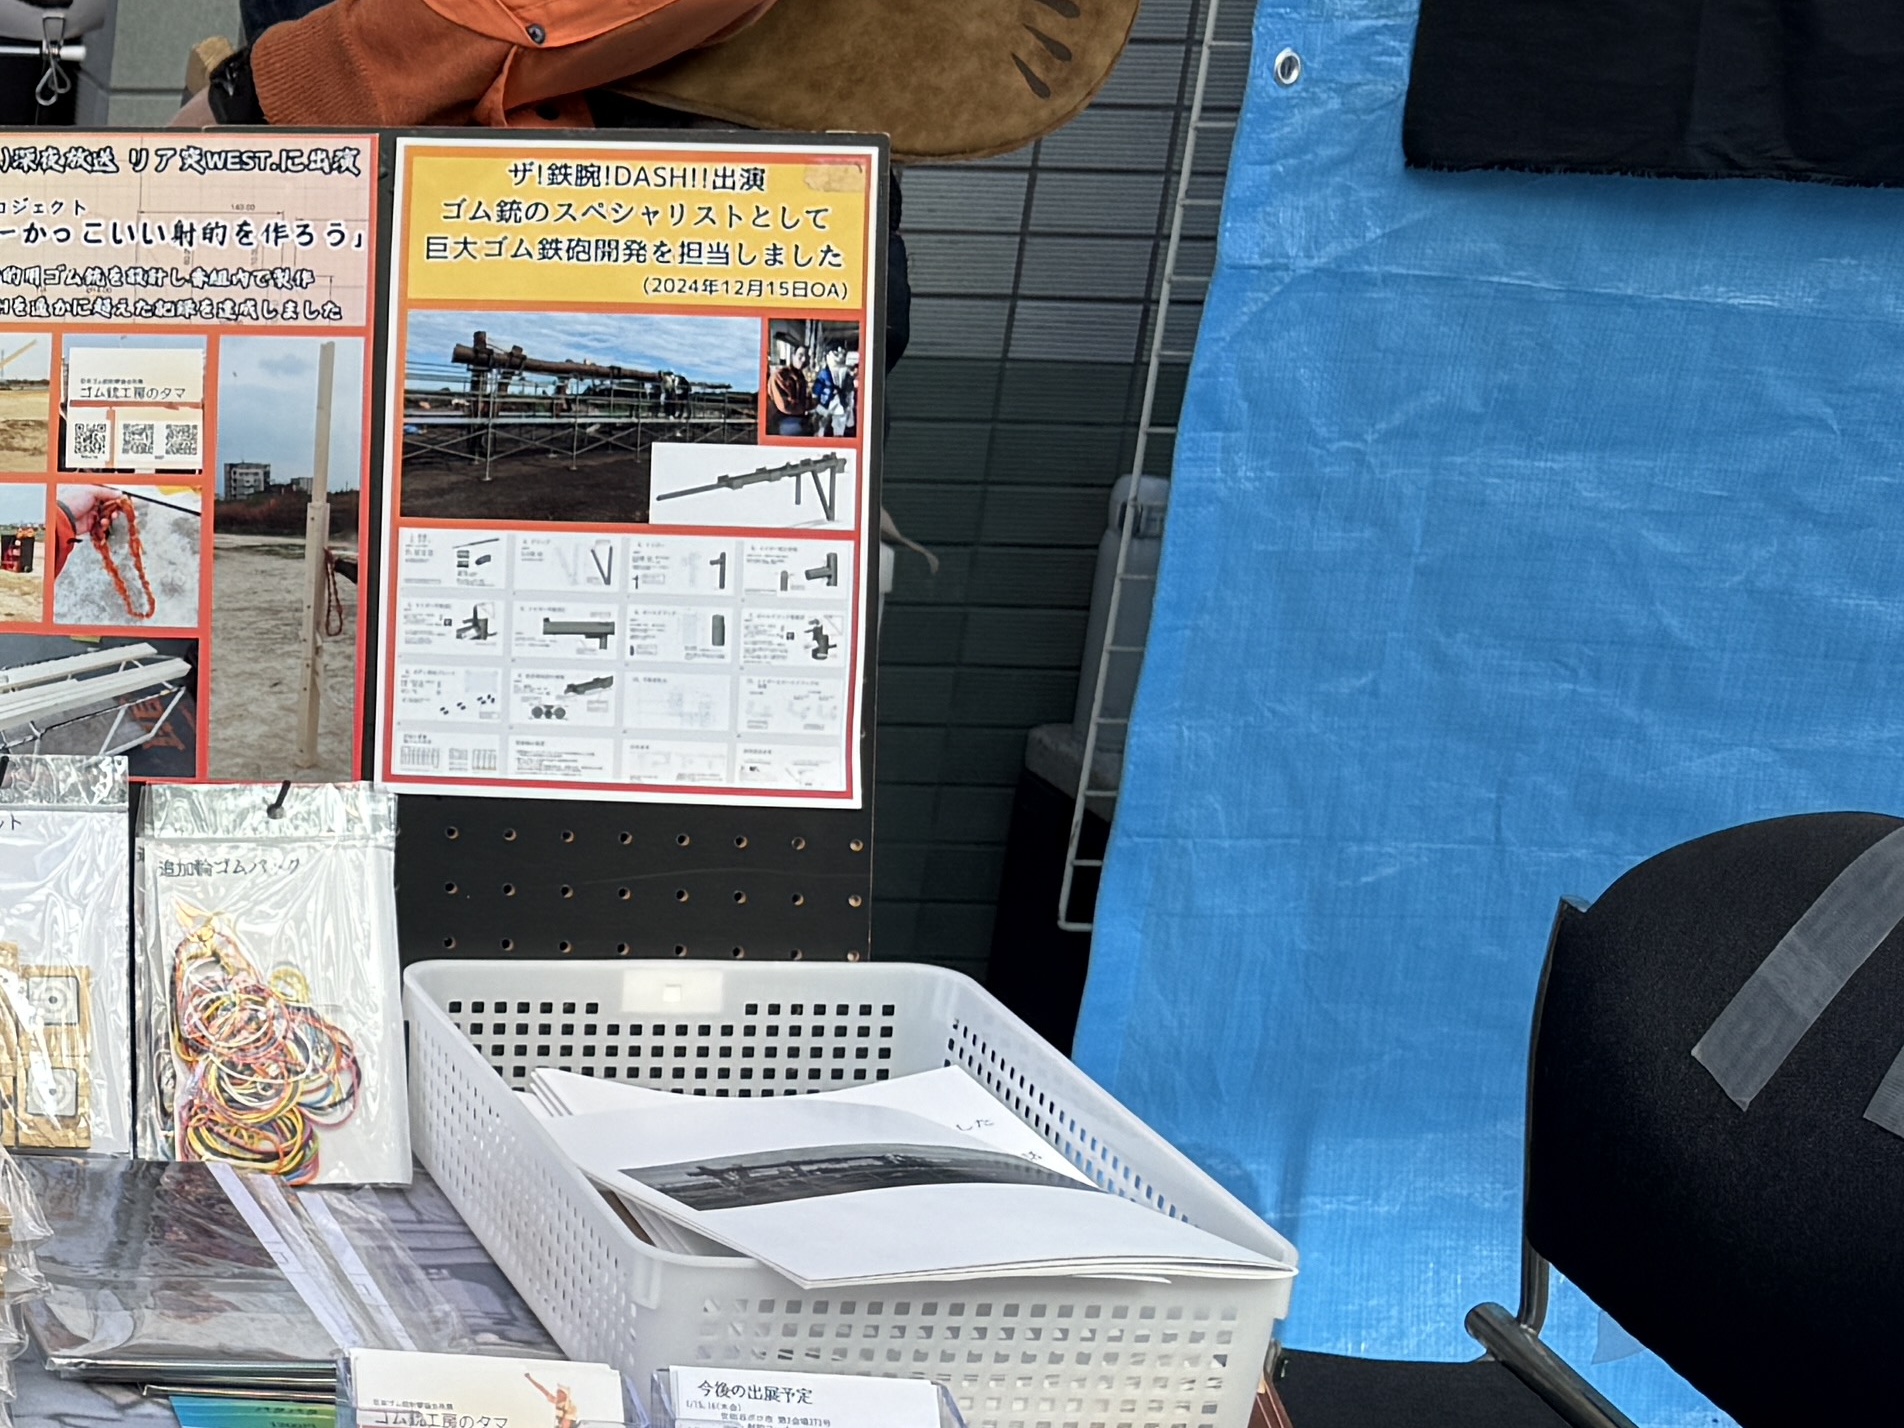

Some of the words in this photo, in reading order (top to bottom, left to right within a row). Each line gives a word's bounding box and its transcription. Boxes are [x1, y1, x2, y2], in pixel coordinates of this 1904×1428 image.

[508, 161, 767, 192] ザ!鉄腕!DASH!!出演
[441, 196, 830, 231] ゴム銃のスペシャリストとして
[425, 235, 844, 269] 巨大ゴム鉄砲開発を担当しました
[642, 276, 849, 301] (2024年12月15日OA)
[697, 1379, 814, 1405] 今後の出展予定
